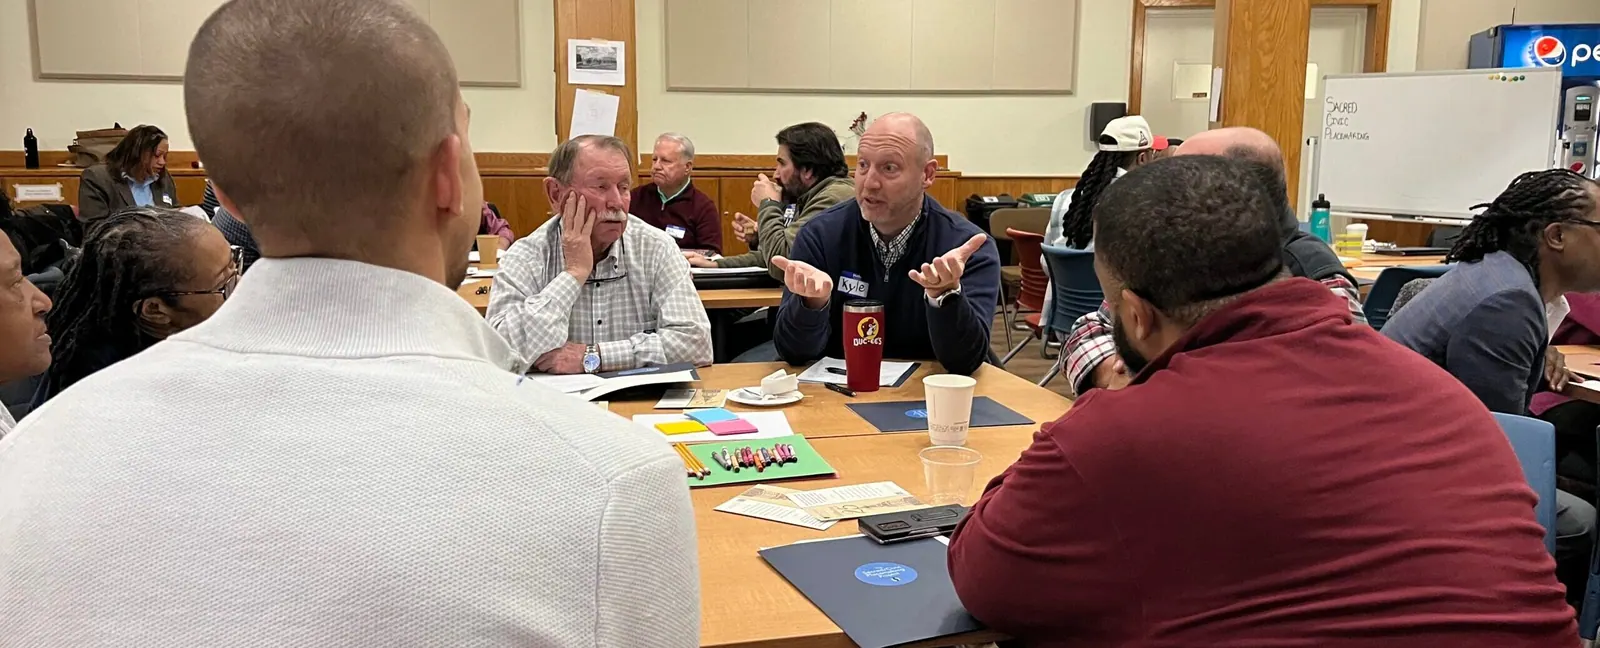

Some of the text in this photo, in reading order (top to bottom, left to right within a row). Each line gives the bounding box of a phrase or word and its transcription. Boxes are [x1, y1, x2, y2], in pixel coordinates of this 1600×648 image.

[1326, 96, 1358, 114] SACRED
[1326, 112, 1349, 127] CIVIC
[841, 278, 866, 293] Kyle
